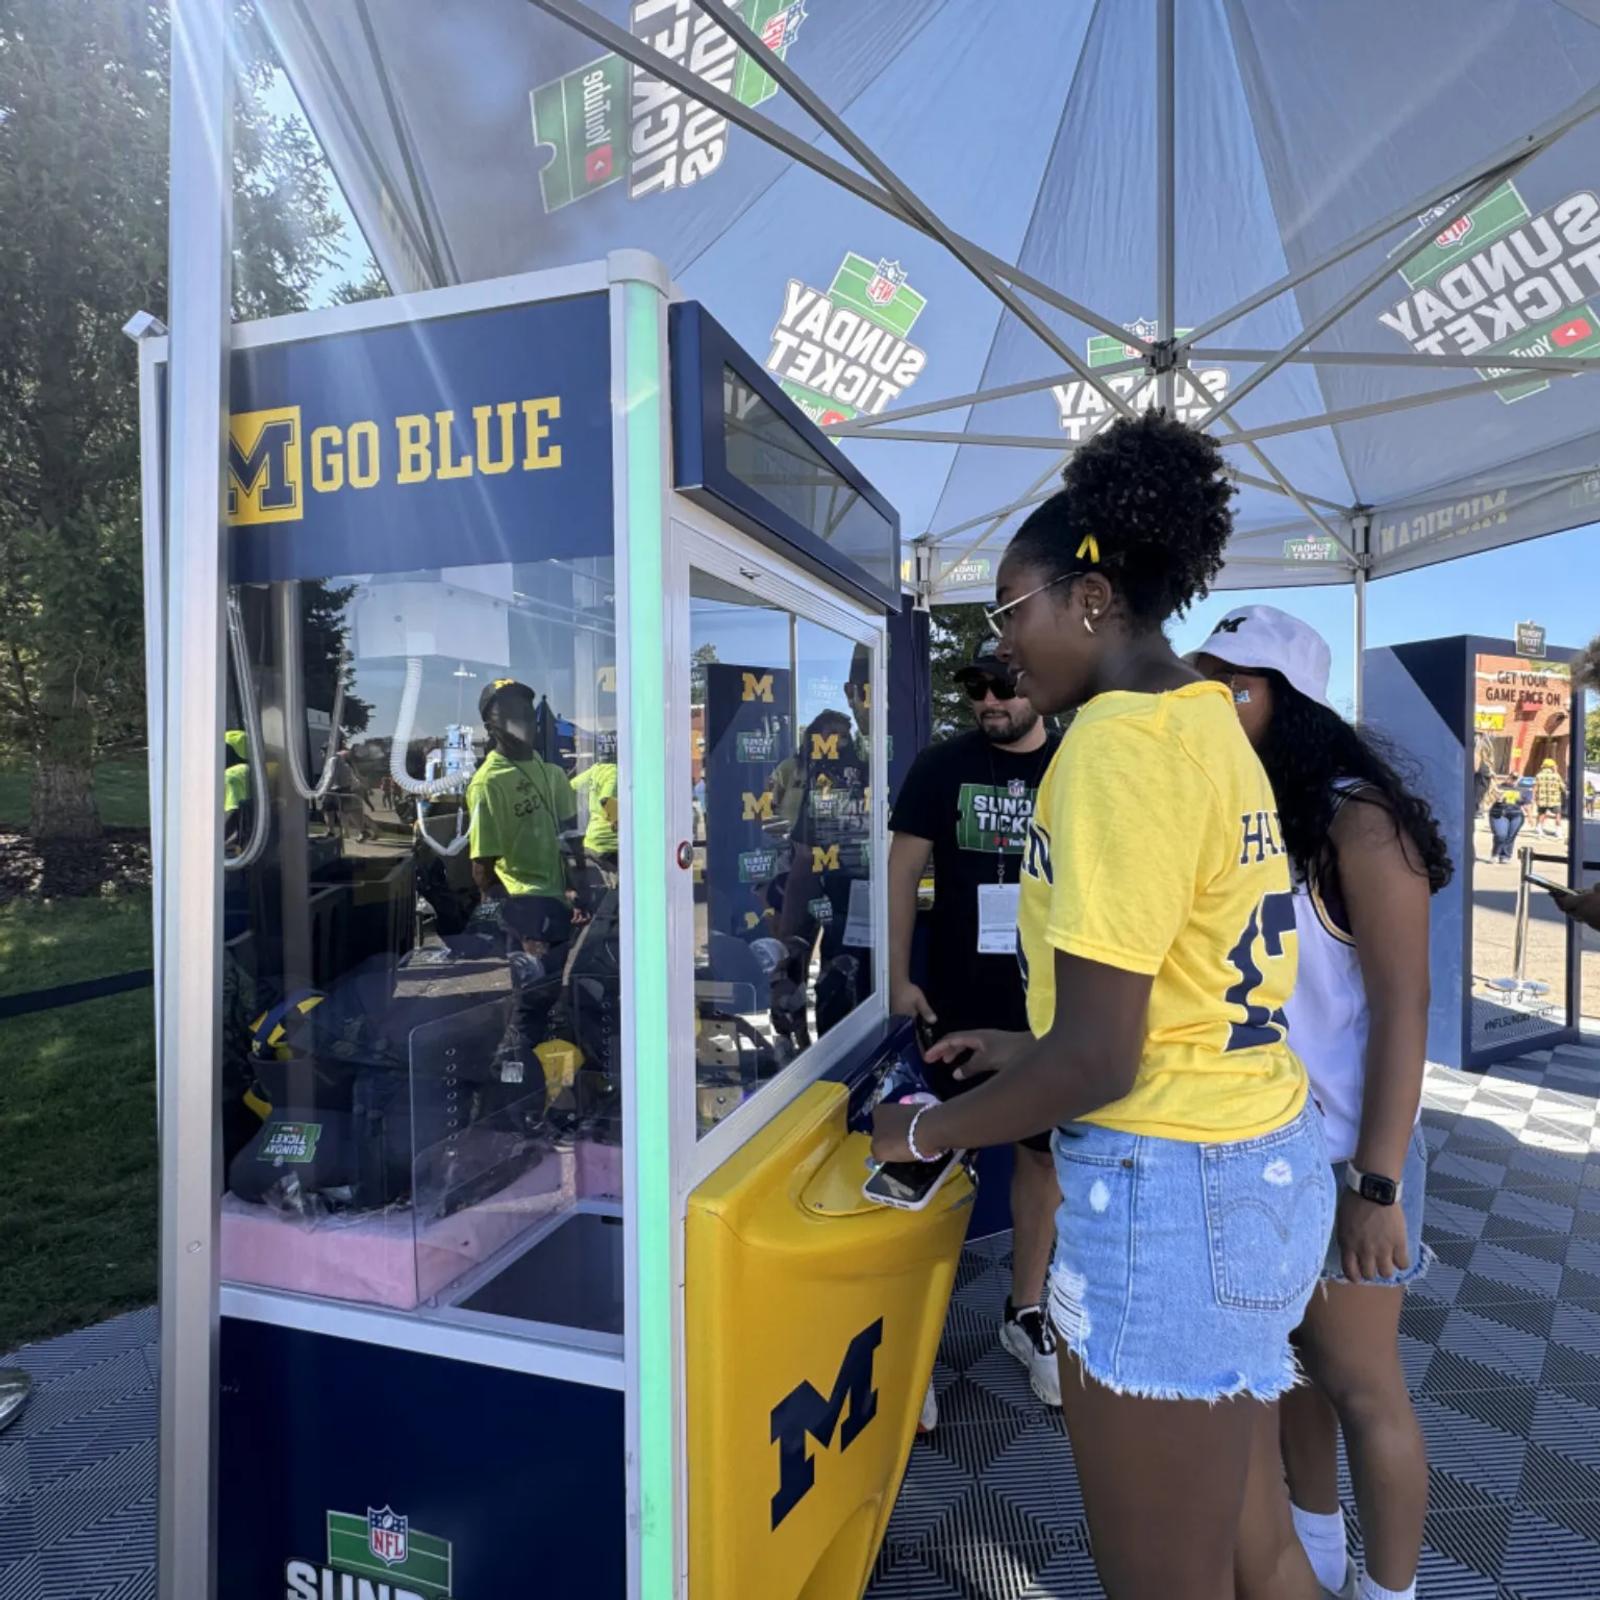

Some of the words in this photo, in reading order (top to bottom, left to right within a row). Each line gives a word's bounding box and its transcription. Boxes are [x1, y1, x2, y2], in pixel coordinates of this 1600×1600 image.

[310, 420, 380, 493] GO
[395, 396, 562, 484] BLUE
[742, 672, 774, 703] M
[1497, 671, 1517, 685] GET
[1520, 675, 1549, 688] YOUR
[1485, 686, 1517, 703] GAME
[1518, 689, 1545, 705] FACE
[1546, 692, 1561, 706] ON
[811, 733, 839, 760] M
[742, 791, 774, 821] M
[973, 795, 1033, 816] SUND
[976, 811, 1032, 834] TICK
[1240, 811, 1286, 865] HA
[812, 844, 840, 873] M
[263, 1144, 306, 1156] SUNDAY
[269, 1134, 307, 1145] TICKET
[770, 1315, 884, 1533] M
[373, 1530, 404, 1557] NFL
